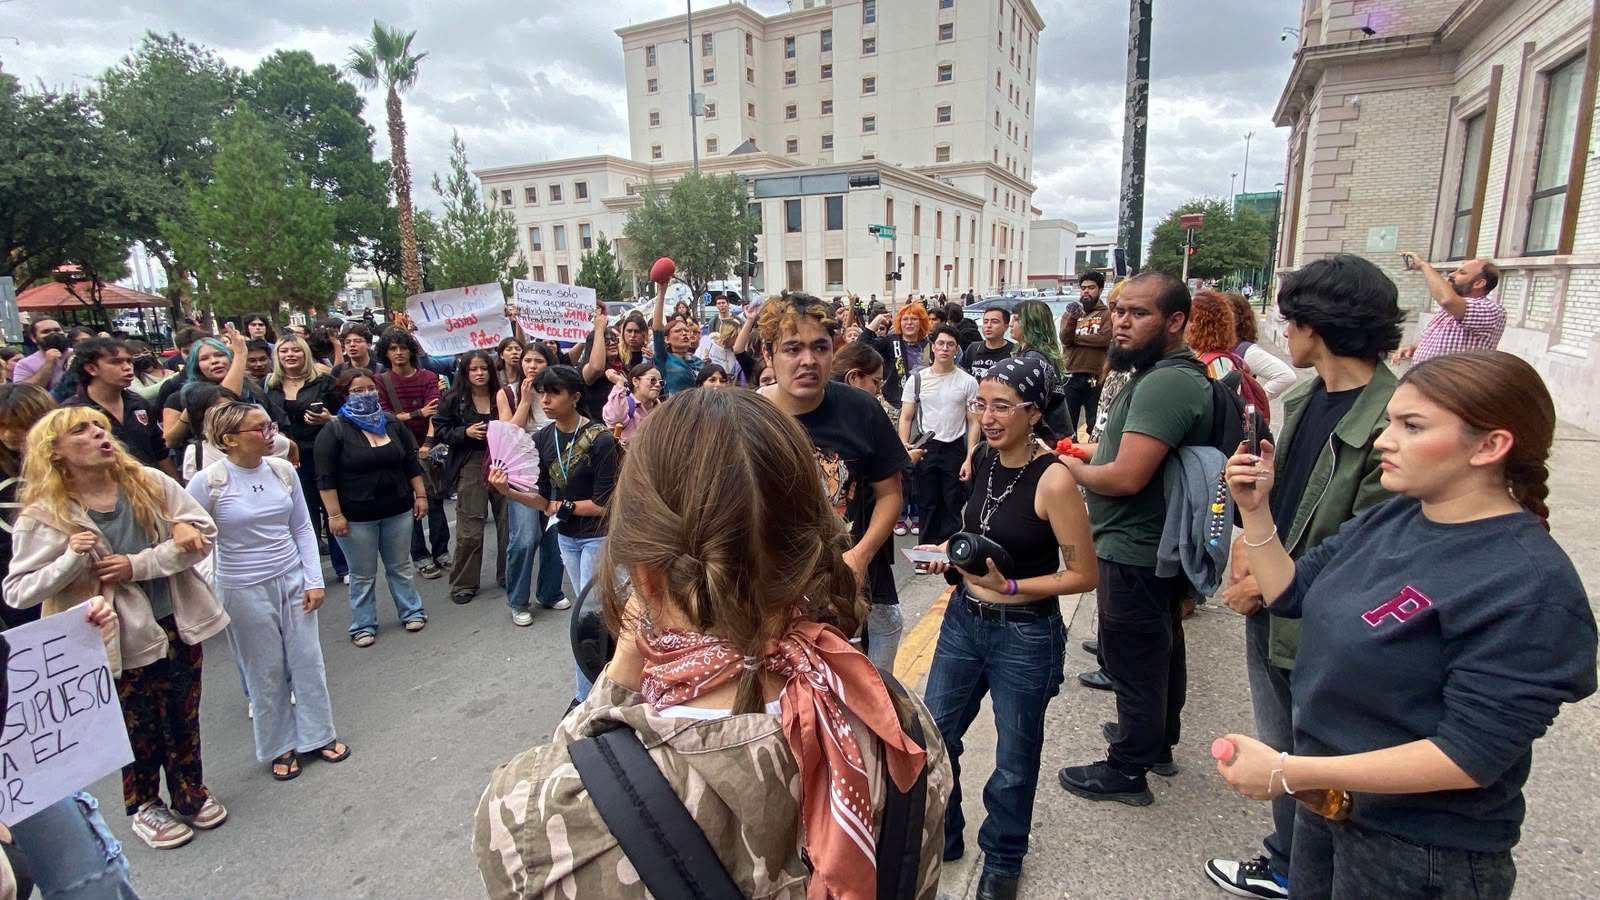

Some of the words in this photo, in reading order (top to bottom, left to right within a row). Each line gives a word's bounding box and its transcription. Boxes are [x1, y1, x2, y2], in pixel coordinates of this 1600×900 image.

[557, 288, 578, 299] solo
[546, 326, 591, 339] COLECTIV
[1361, 585, 1431, 627] P
[7, 635, 80, 693] SE
[0, 665, 112, 748] SUPUESTO
[31, 730, 79, 764] EL
